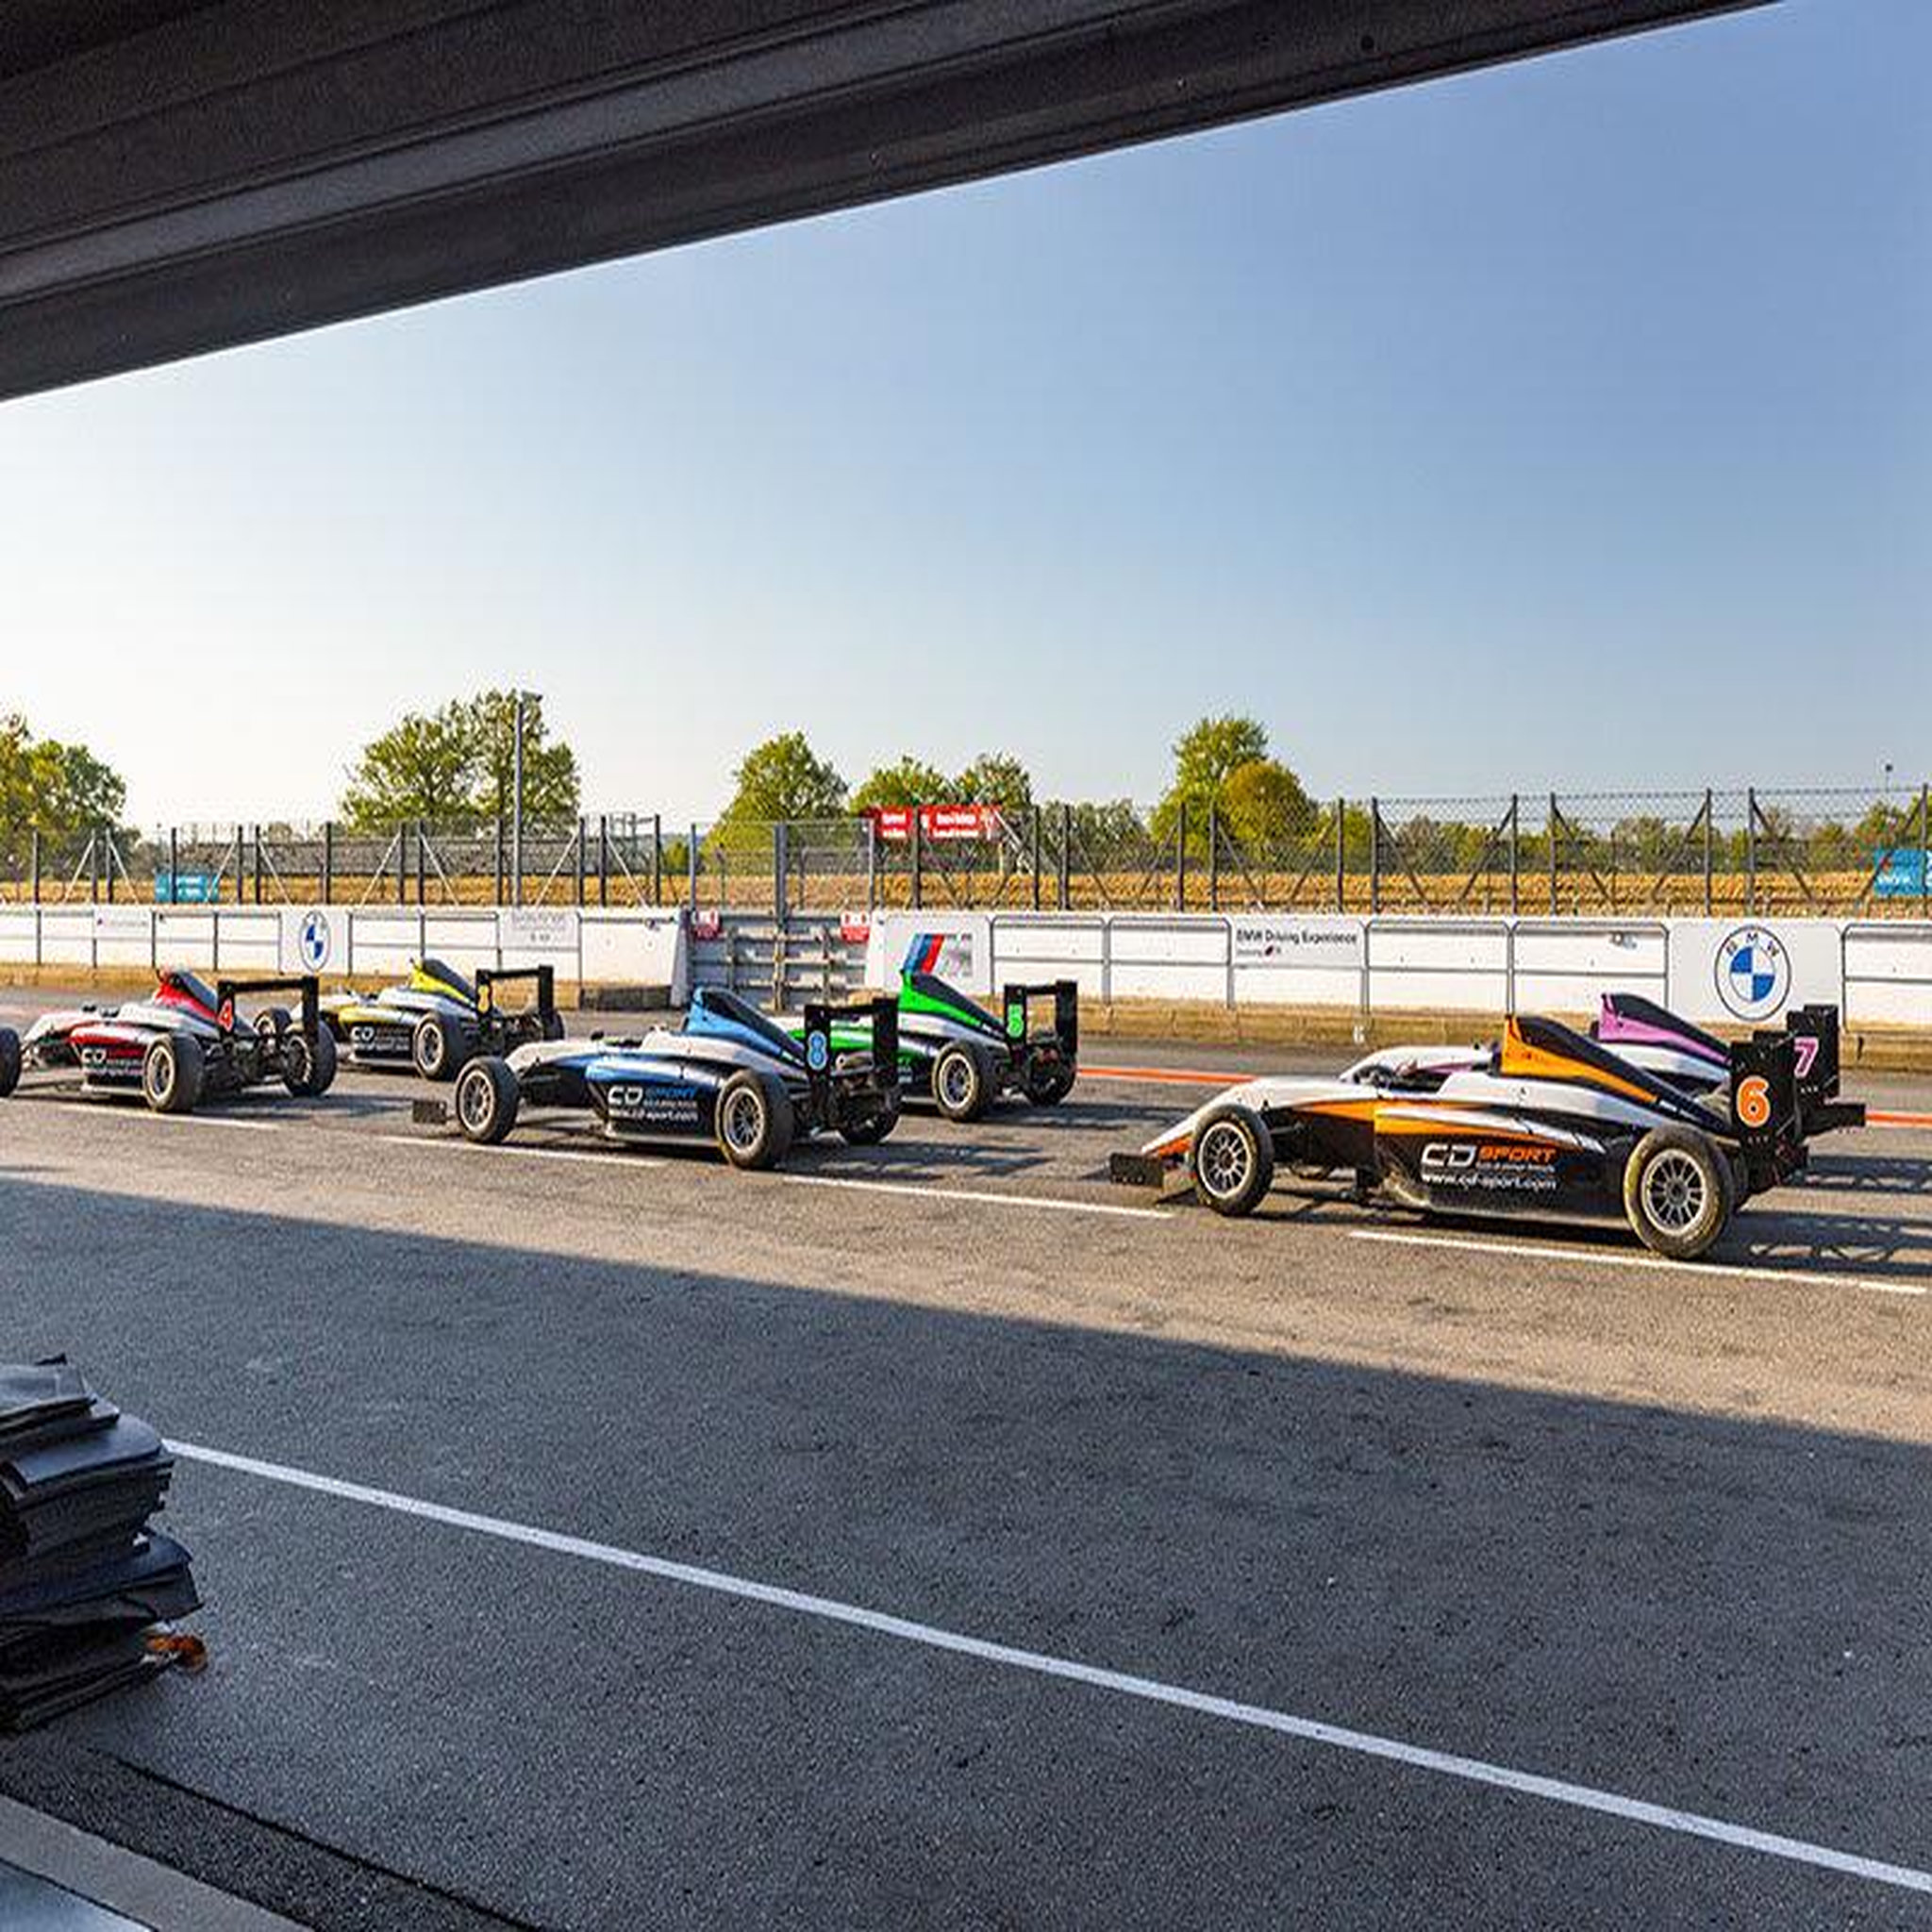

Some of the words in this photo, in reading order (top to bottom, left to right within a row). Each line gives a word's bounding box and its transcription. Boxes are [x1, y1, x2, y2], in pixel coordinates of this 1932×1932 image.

[1265, 929, 1299, 944] Driving
[1301, 930, 1357, 944] Experience
[1725, 932, 1780, 958] BMW
[217, 998, 234, 1032] 4
[807, 1030, 828, 1071] 8
[1794, 1036, 1819, 1077] 7
[608, 1086, 643, 1106] CD
[1736, 1075, 1771, 1128] 6
[1421, 1141, 1477, 1168] CD
[1478, 1144, 1557, 1163] SPORT
[1421, 1171, 1557, 1192] www.cd-sport.com
